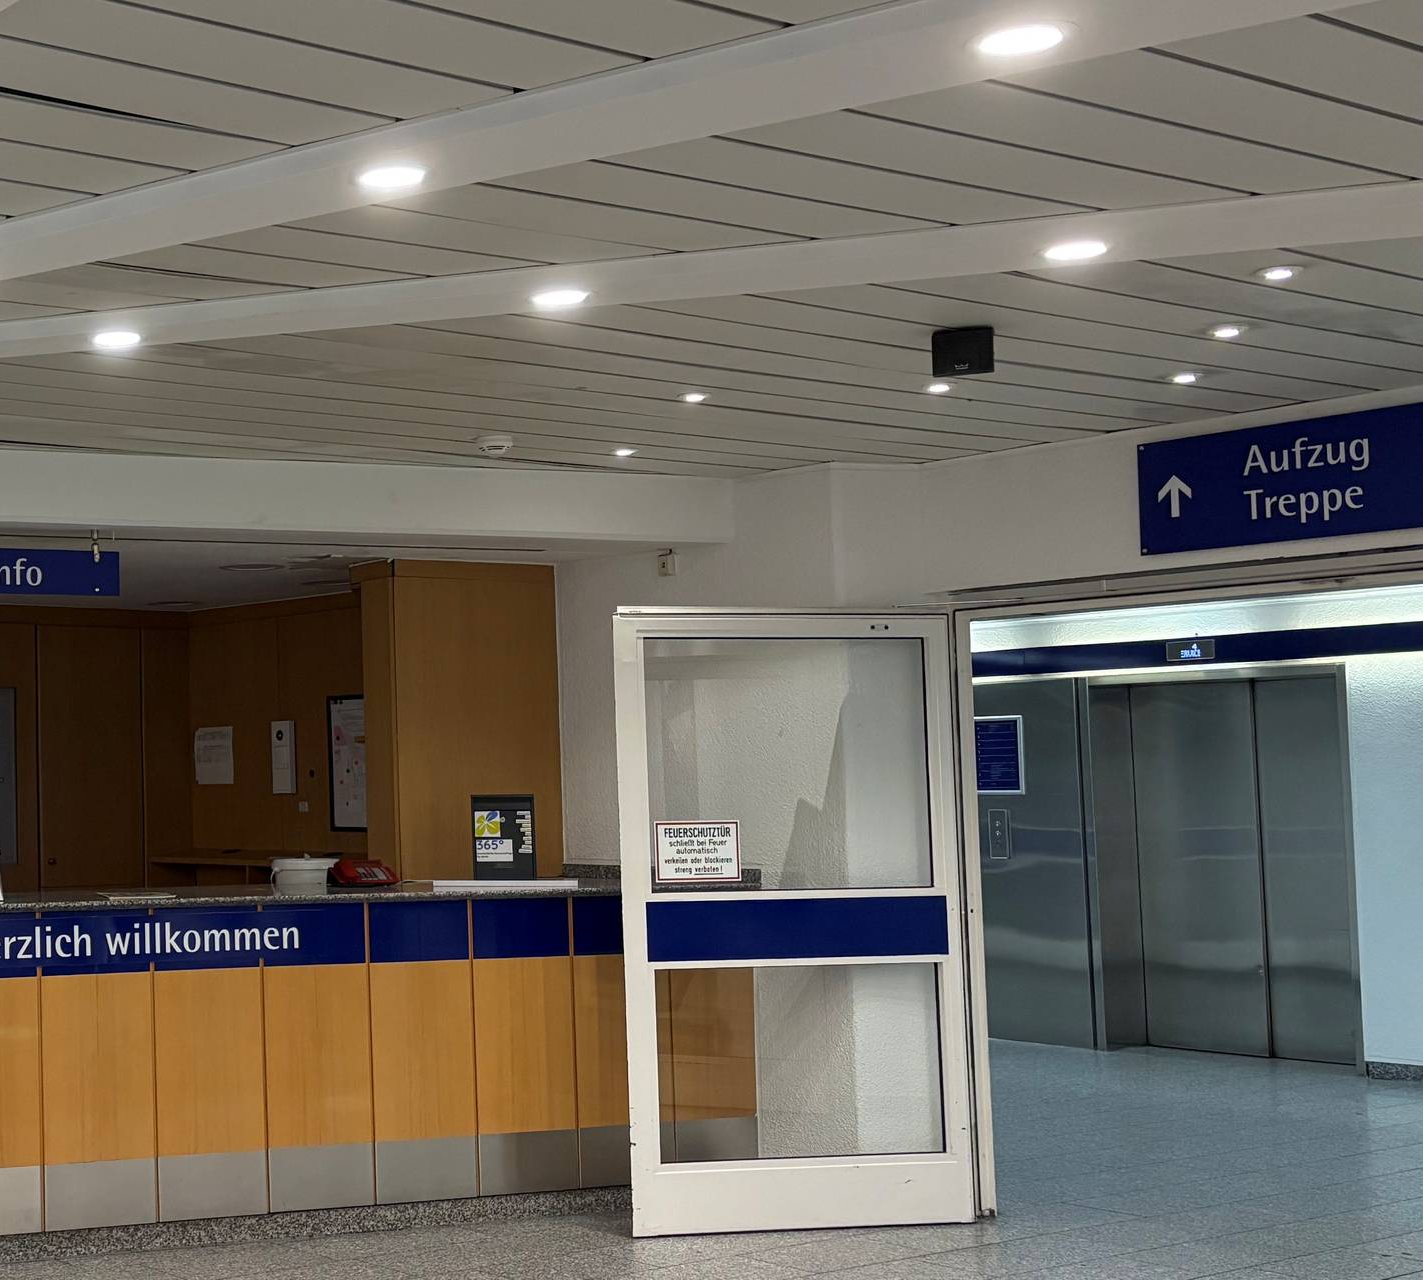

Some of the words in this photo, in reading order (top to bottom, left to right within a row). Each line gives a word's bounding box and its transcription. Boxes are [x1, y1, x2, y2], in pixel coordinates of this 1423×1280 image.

[1243, 437, 1370, 476] Aufzug
[1243, 485, 1364, 524] Treppe
[664, 825, 731, 838] FEUERSCHUTZTÜR
[105, 922, 300, 956] willkommen
